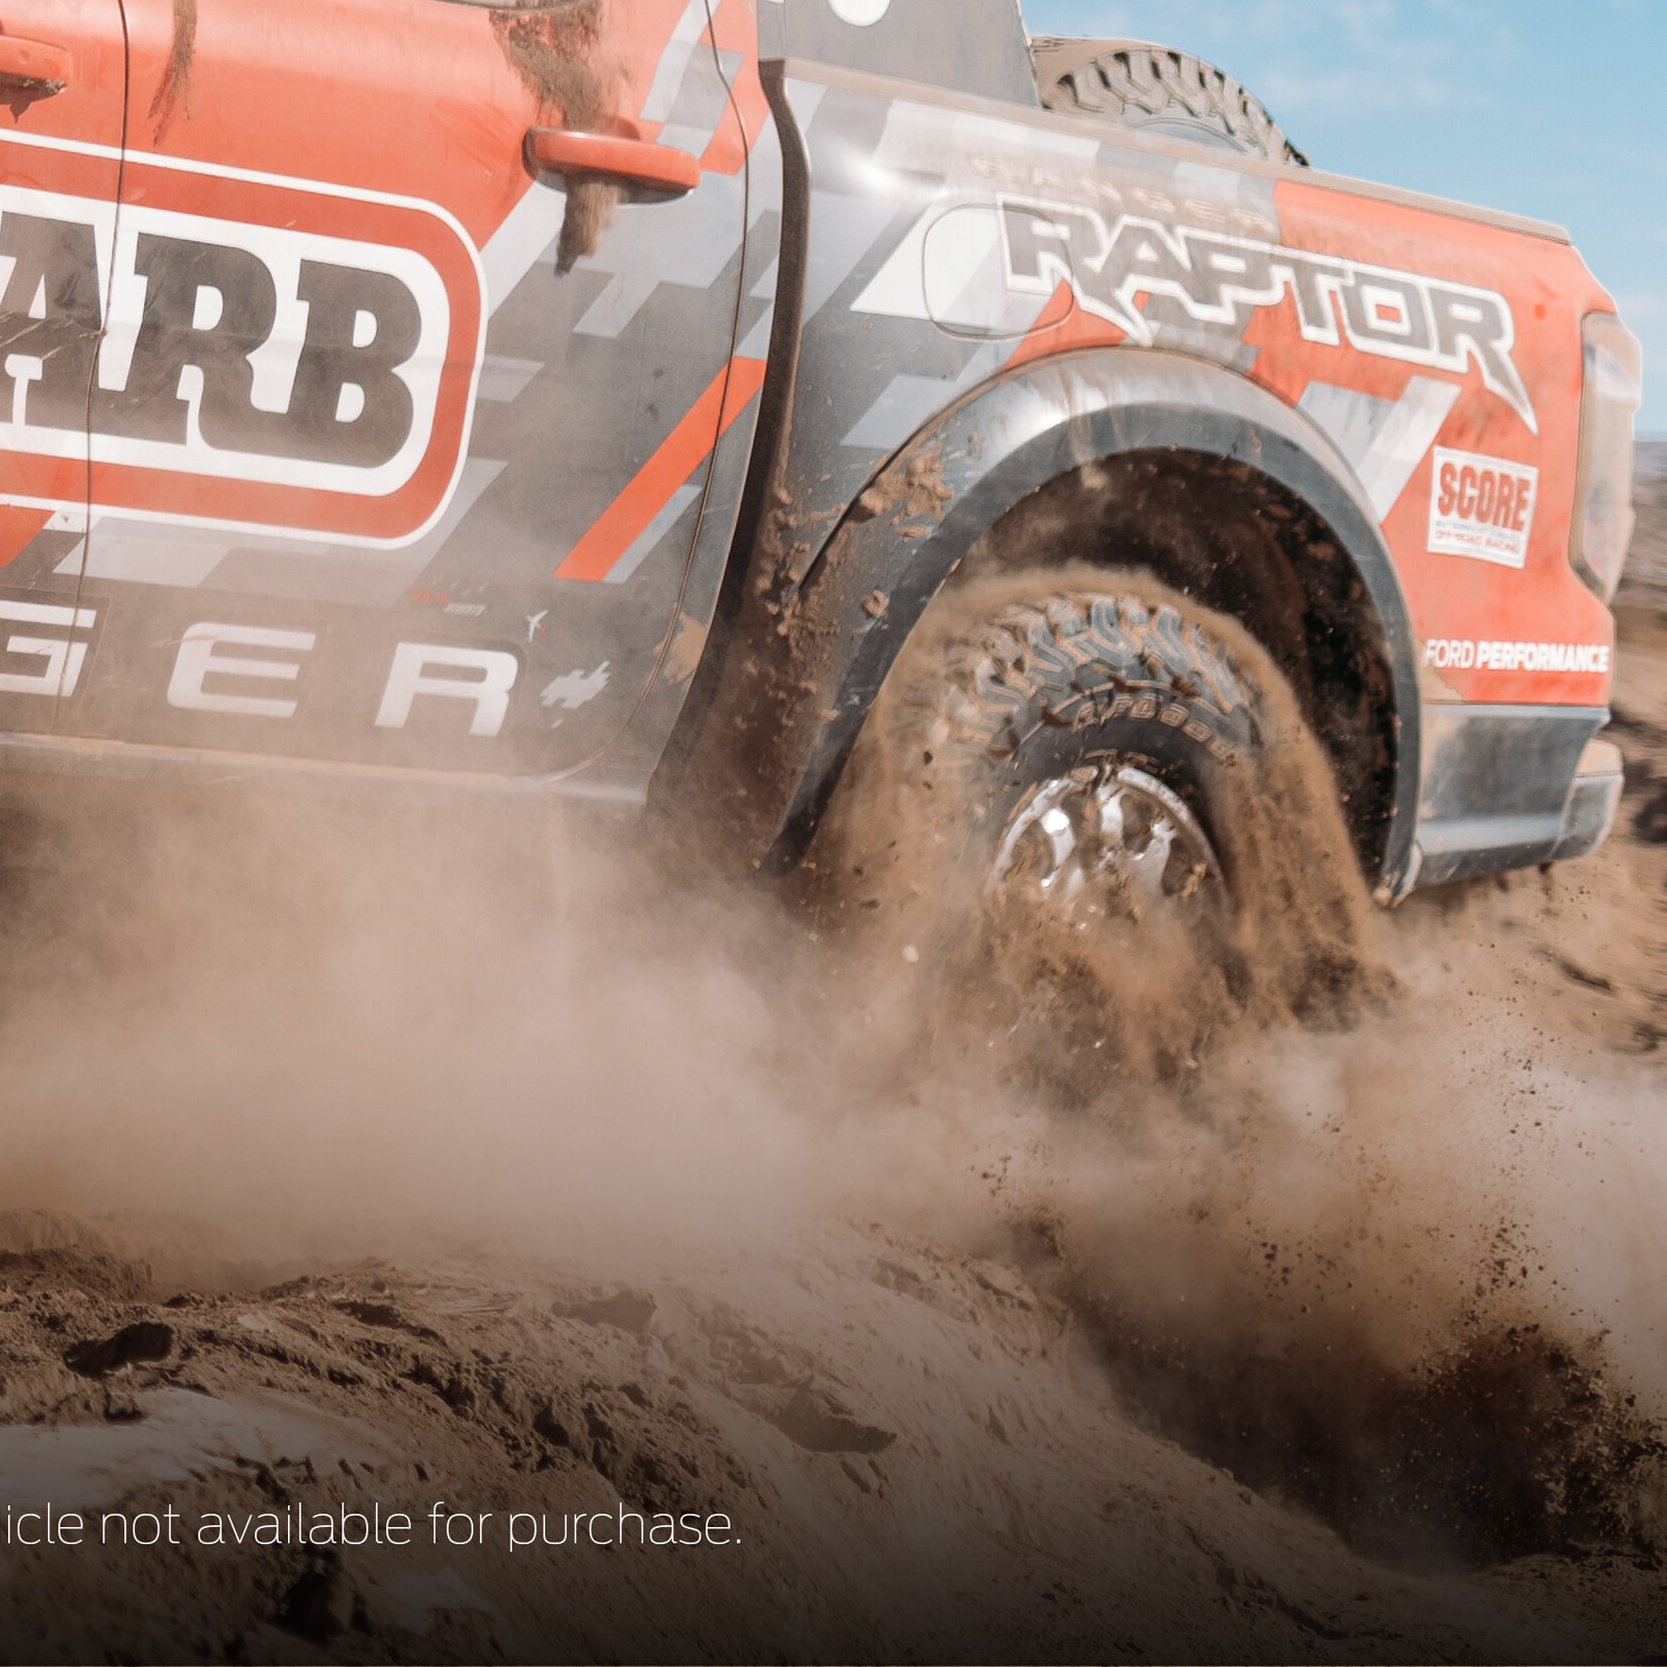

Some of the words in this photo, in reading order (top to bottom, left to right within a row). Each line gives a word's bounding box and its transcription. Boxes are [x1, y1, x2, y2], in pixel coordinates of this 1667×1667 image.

[995, 192, 1537, 436] RAPTOR
[1437, 461, 1531, 532] SCORE
[1421, 638, 1475, 669] FORD
[1475, 640, 1611, 673] PERFORMANCE
